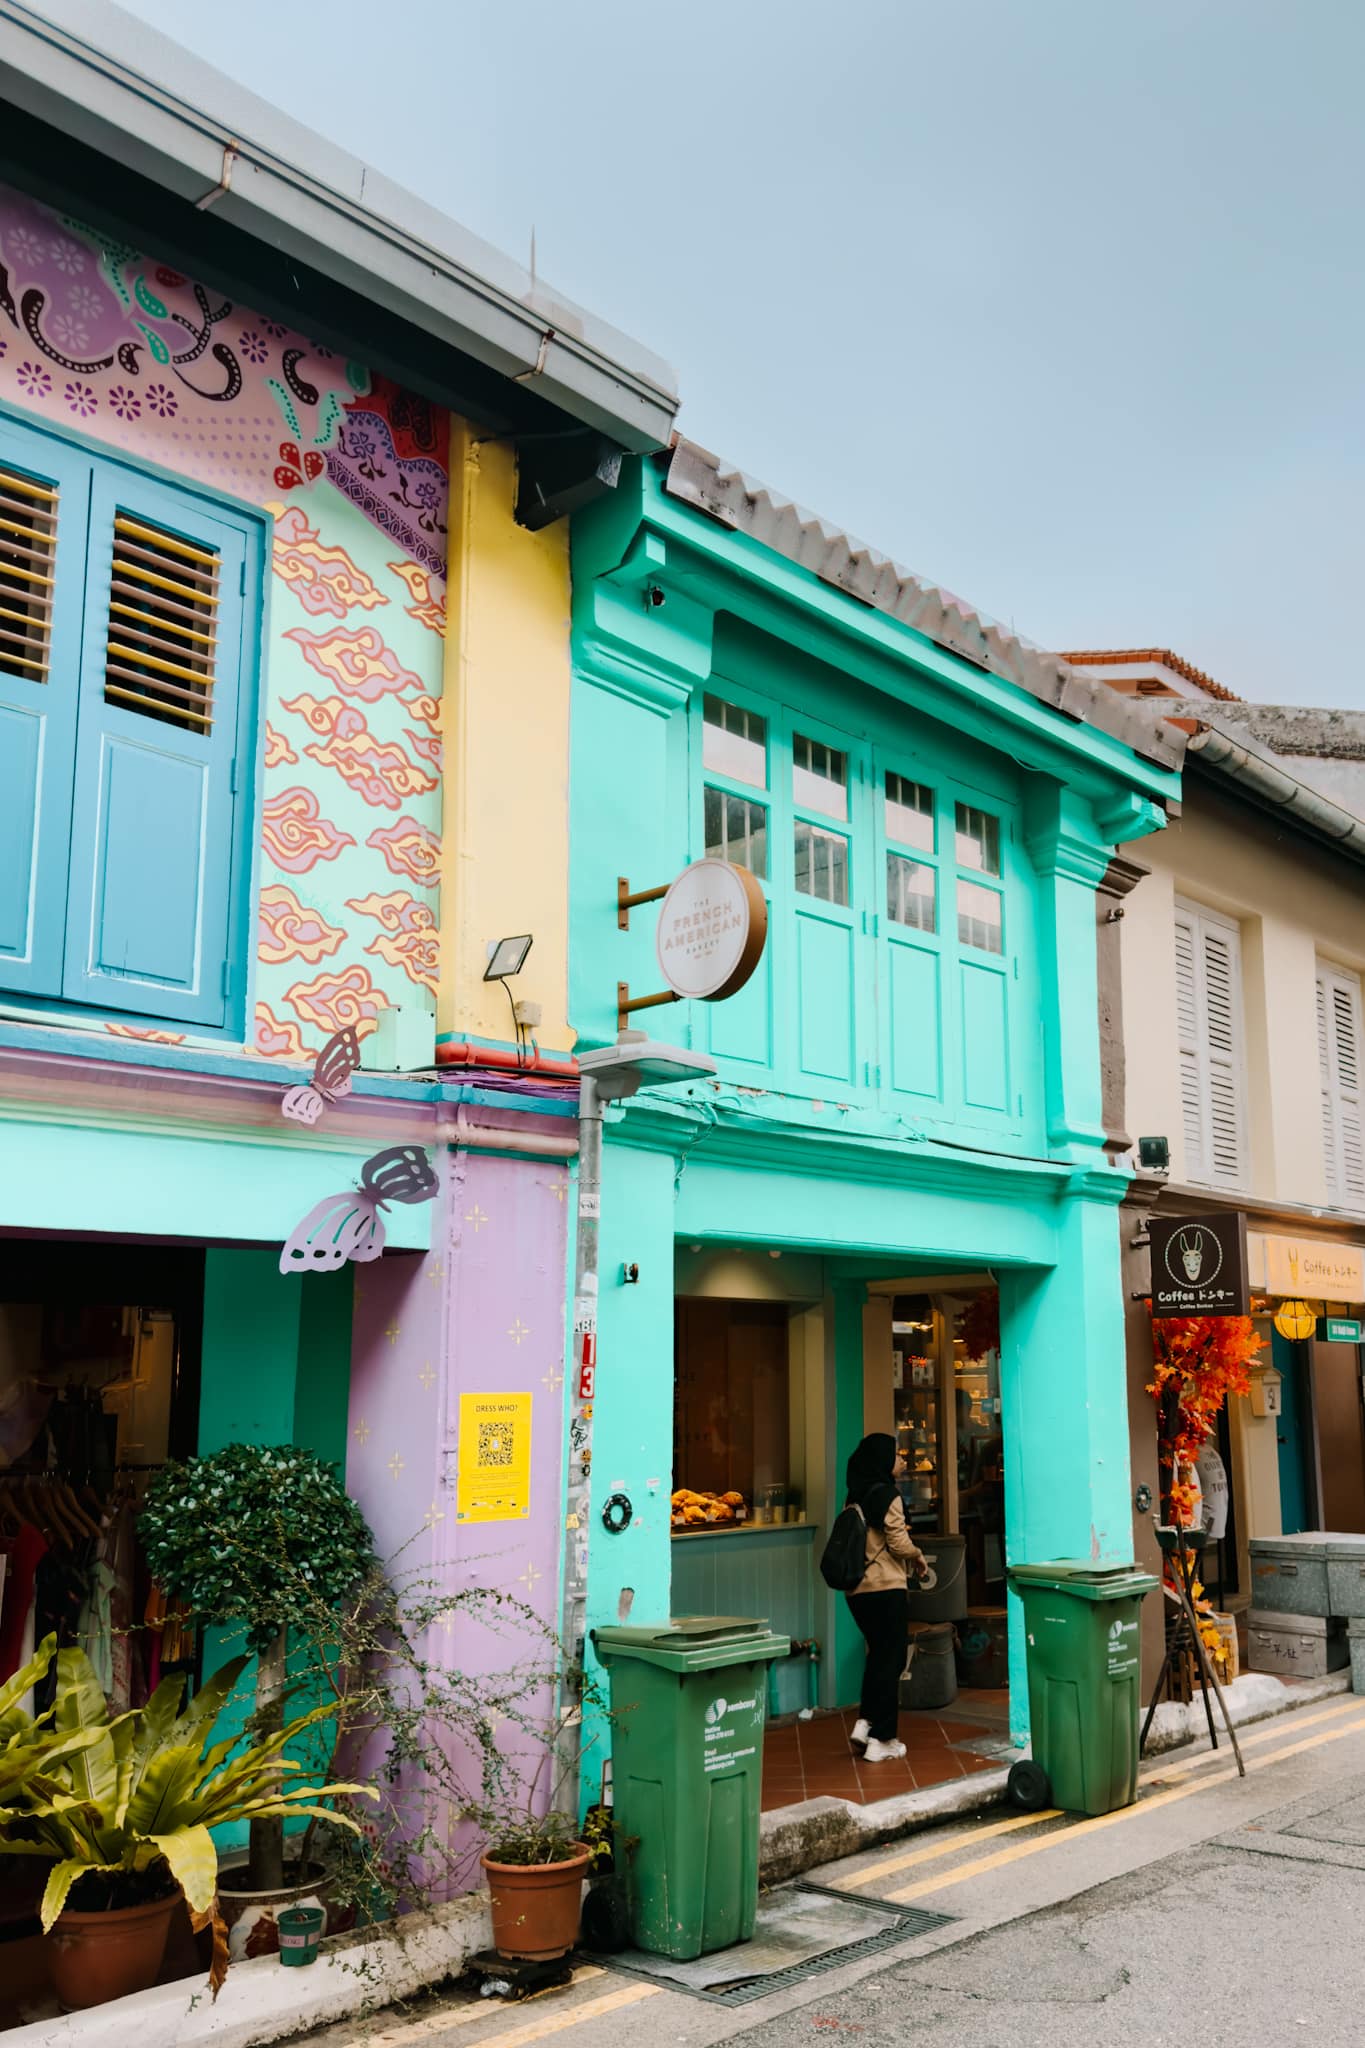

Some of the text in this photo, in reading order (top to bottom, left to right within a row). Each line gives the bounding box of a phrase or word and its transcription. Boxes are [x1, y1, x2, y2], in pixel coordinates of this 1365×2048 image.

[673, 903, 732, 932] FRENCH
[665, 914, 741, 951] AMERICAN
[1304, 1259, 1331, 1276] Coffee
[1158, 1290, 1195, 1302] Coffee
[475, 1405, 497, 1413] DRESS
